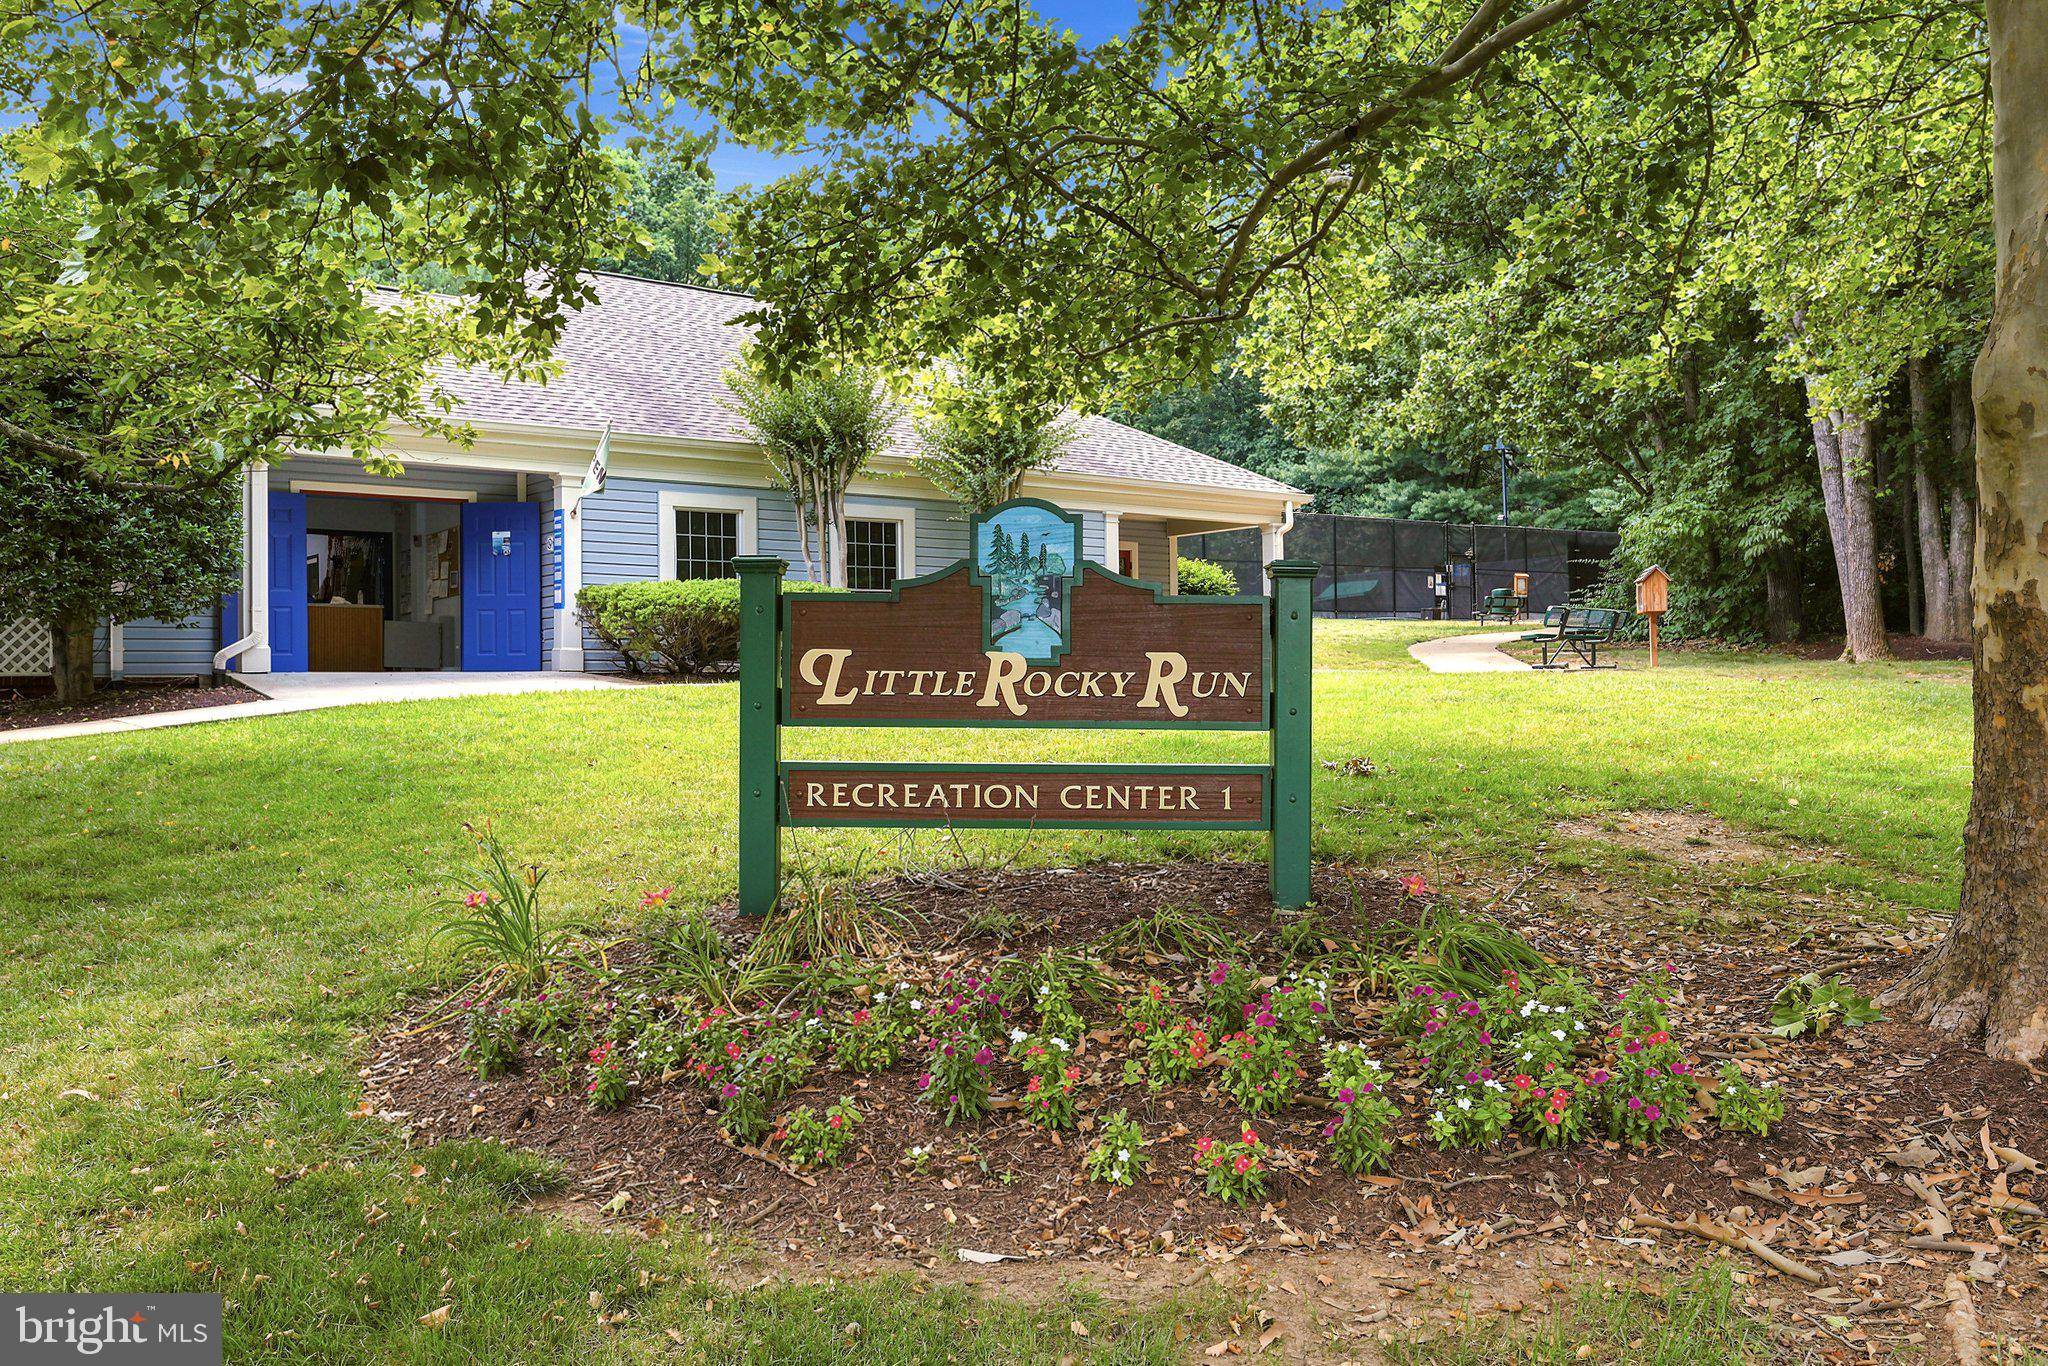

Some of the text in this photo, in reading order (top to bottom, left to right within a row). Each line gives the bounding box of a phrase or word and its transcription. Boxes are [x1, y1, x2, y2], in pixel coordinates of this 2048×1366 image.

[799, 648, 1253, 718] LITTLE ROCKY RUN
[806, 782, 1232, 810] RECREATION CENTER 1
